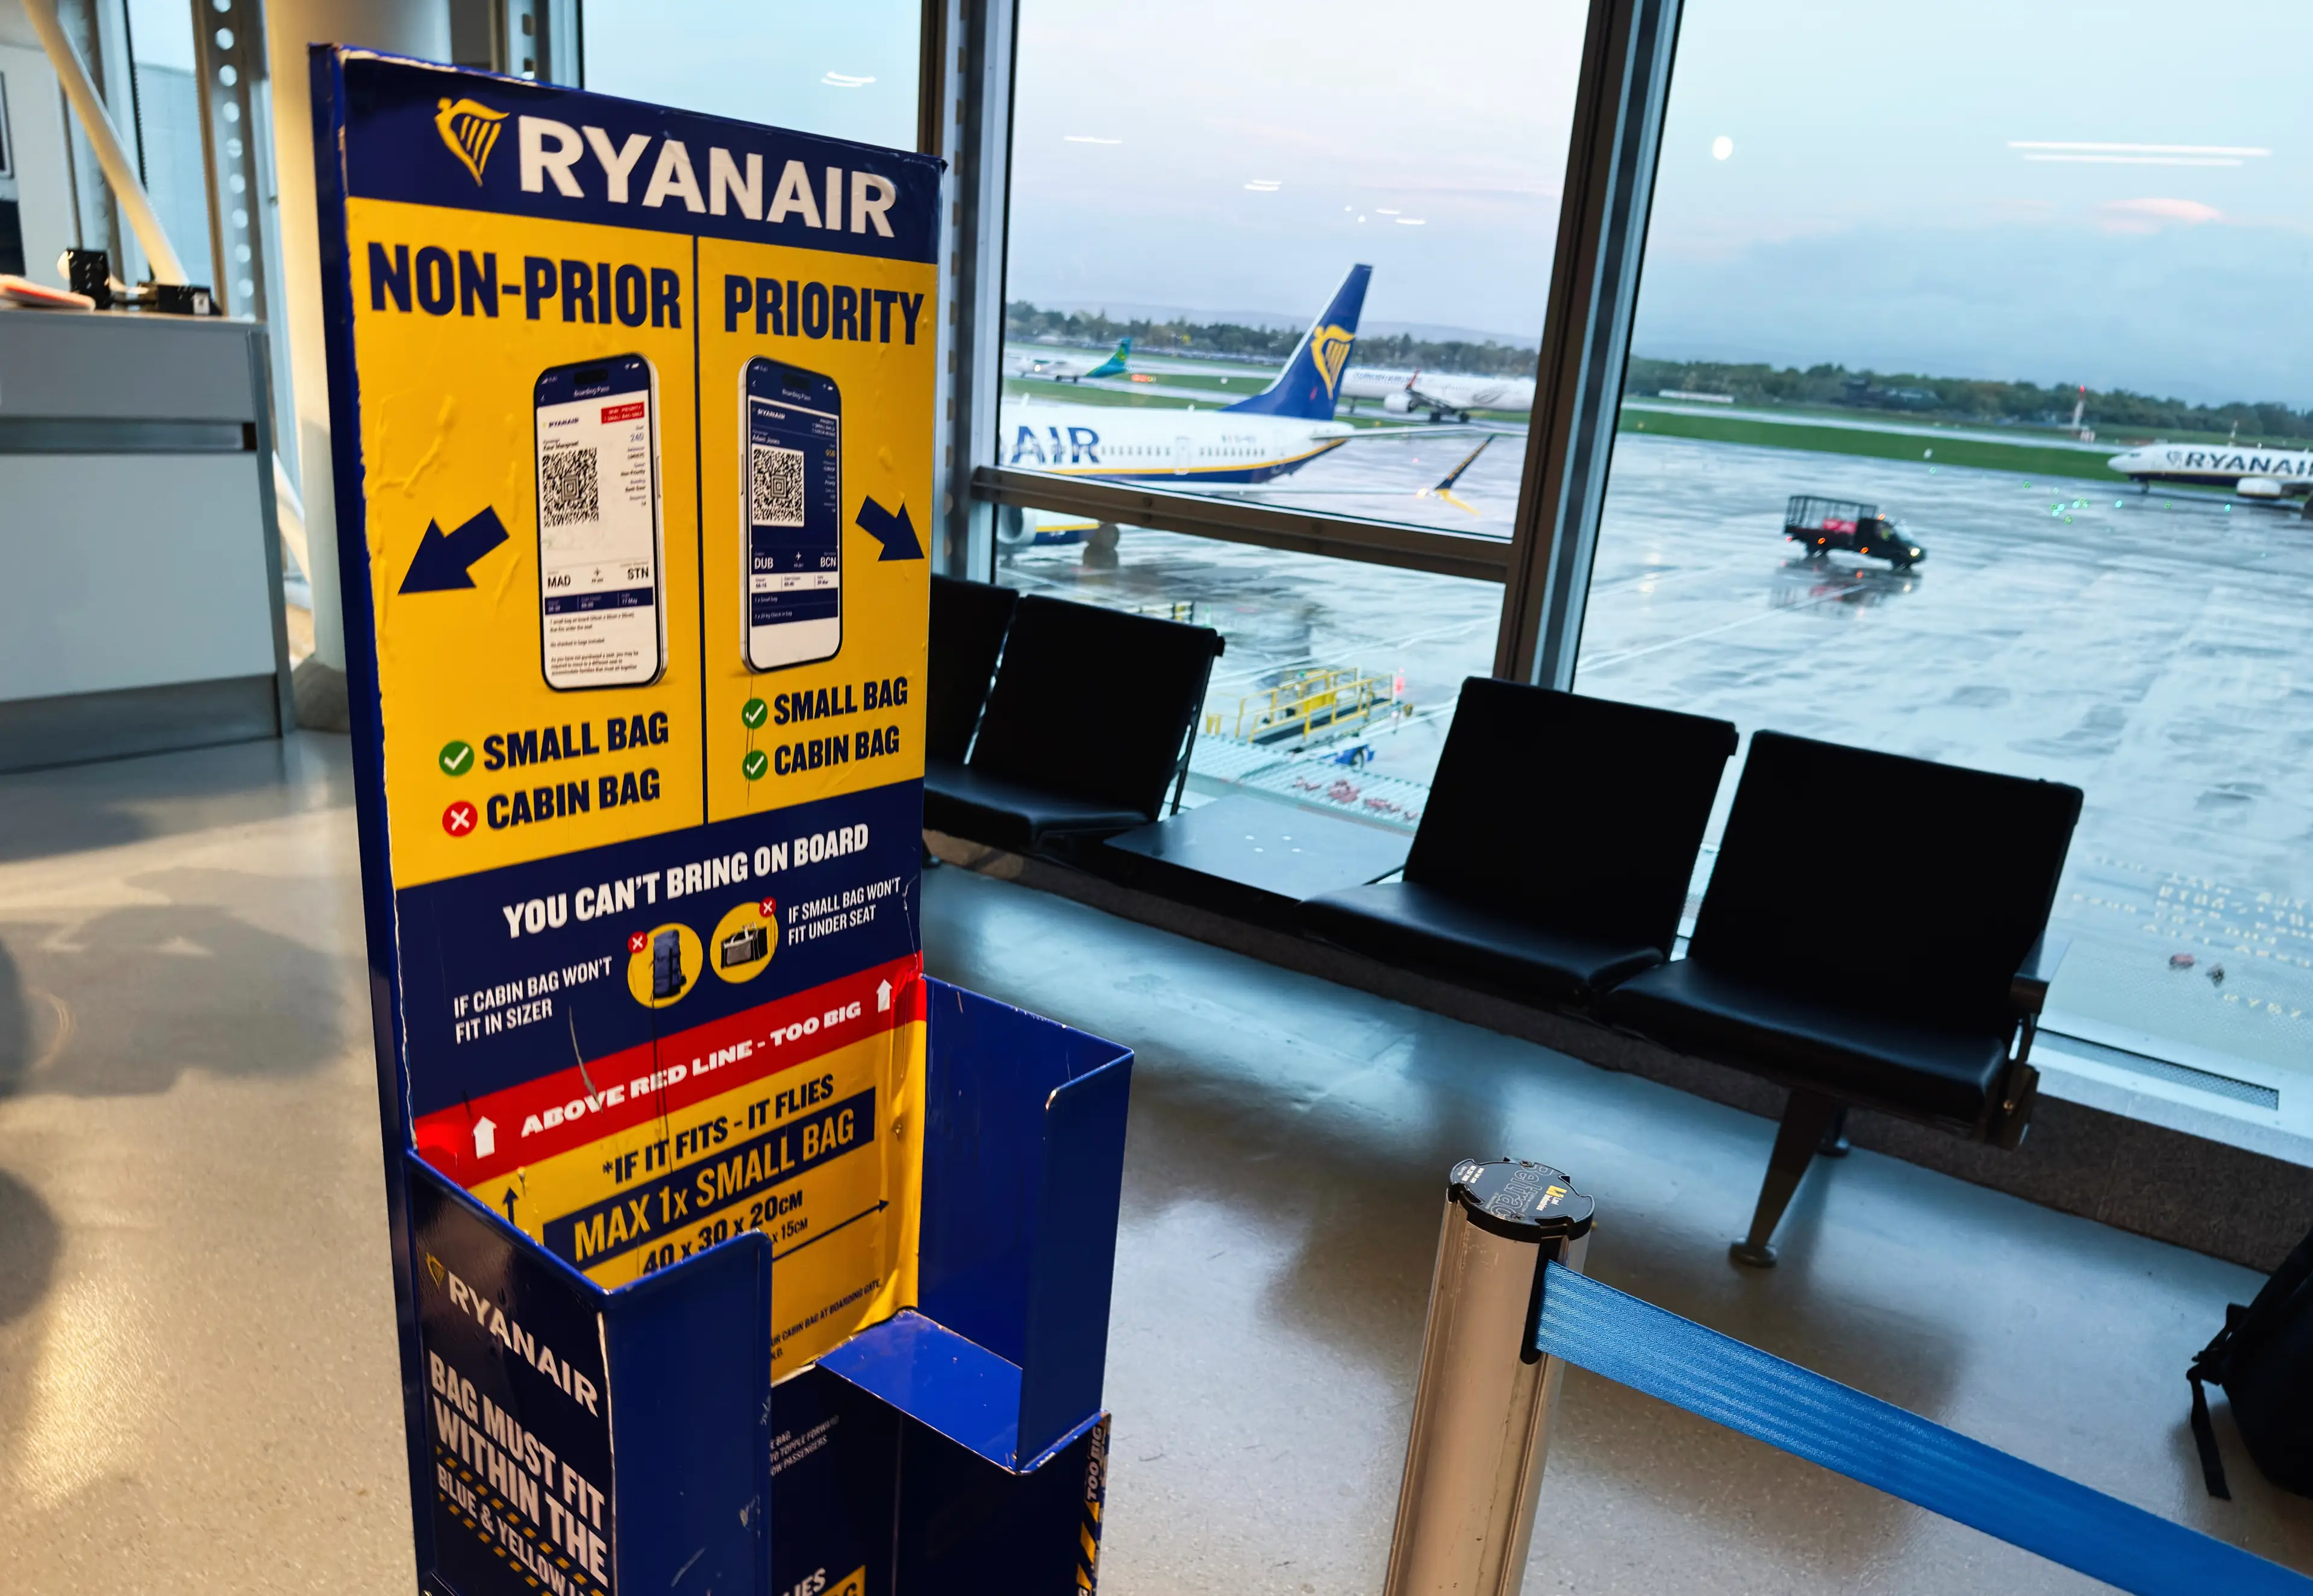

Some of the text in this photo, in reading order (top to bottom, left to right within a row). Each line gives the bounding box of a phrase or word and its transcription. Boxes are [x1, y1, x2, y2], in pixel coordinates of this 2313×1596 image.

[518, 115, 896, 238] RYANAIR
[368, 241, 682, 329] NON-PRIOR
[724, 274, 924, 346] PRIORITY
[1010, 426, 1100, 464] AIR
[548, 575, 571, 588] MAD
[628, 567, 649, 580] STN
[754, 557, 773, 569] DUB
[820, 556, 836, 567] BCN
[773, 676, 908, 725] SMALL BAG
[483, 711, 669, 771] SMALL BAG
[774, 725, 900, 776] CABIN BAG
[487, 768, 661, 830] CABIN BAG
[503, 823, 869, 940] YOU CAN'T BRING ON BOARD
[788, 877, 902, 924] IF SMALL BAG WON'T
[788, 904, 876, 946] FIT UNDER SEAT
[454, 956, 613, 1018] IF CABIN BAG WON'T
[455, 998, 552, 1044] FIT IN SIZER
[520, 1089, 625, 1138] ABOVE
[629, 1064, 687, 1100] RED
[691, 1040, 753, 1077] LINE
[770, 1016, 819, 1047] TOO
[823, 1001, 861, 1030] BIG
[644, 1139, 671, 1173] IT
[676, 1117, 728, 1158] FITS
[748, 1098, 771, 1130] IT
[776, 1074, 834, 1120] FLIES
[573, 1194, 651, 1263] MAX
[696, 1136, 795, 1208] SMALL
[803, 1109, 855, 1159] BAG
[643, 1243, 675, 1275] 40
[698, 1219, 728, 1252] 30
[820, 1307, 829, 1320] AT
[448, 1270, 598, 1418] RYANAIR
[429, 1349, 605, 1531] BAG MUST FIT
[779, 1434, 806, 1456] TOPPLE
[784, 1434, 827, 1468] PASSENGERS
[432, 1394, 608, 1588] WITHIN THE
[1087, 1460, 1100, 1501] TOO
[437, 1462, 566, 1596] BLUE & YELLOW
